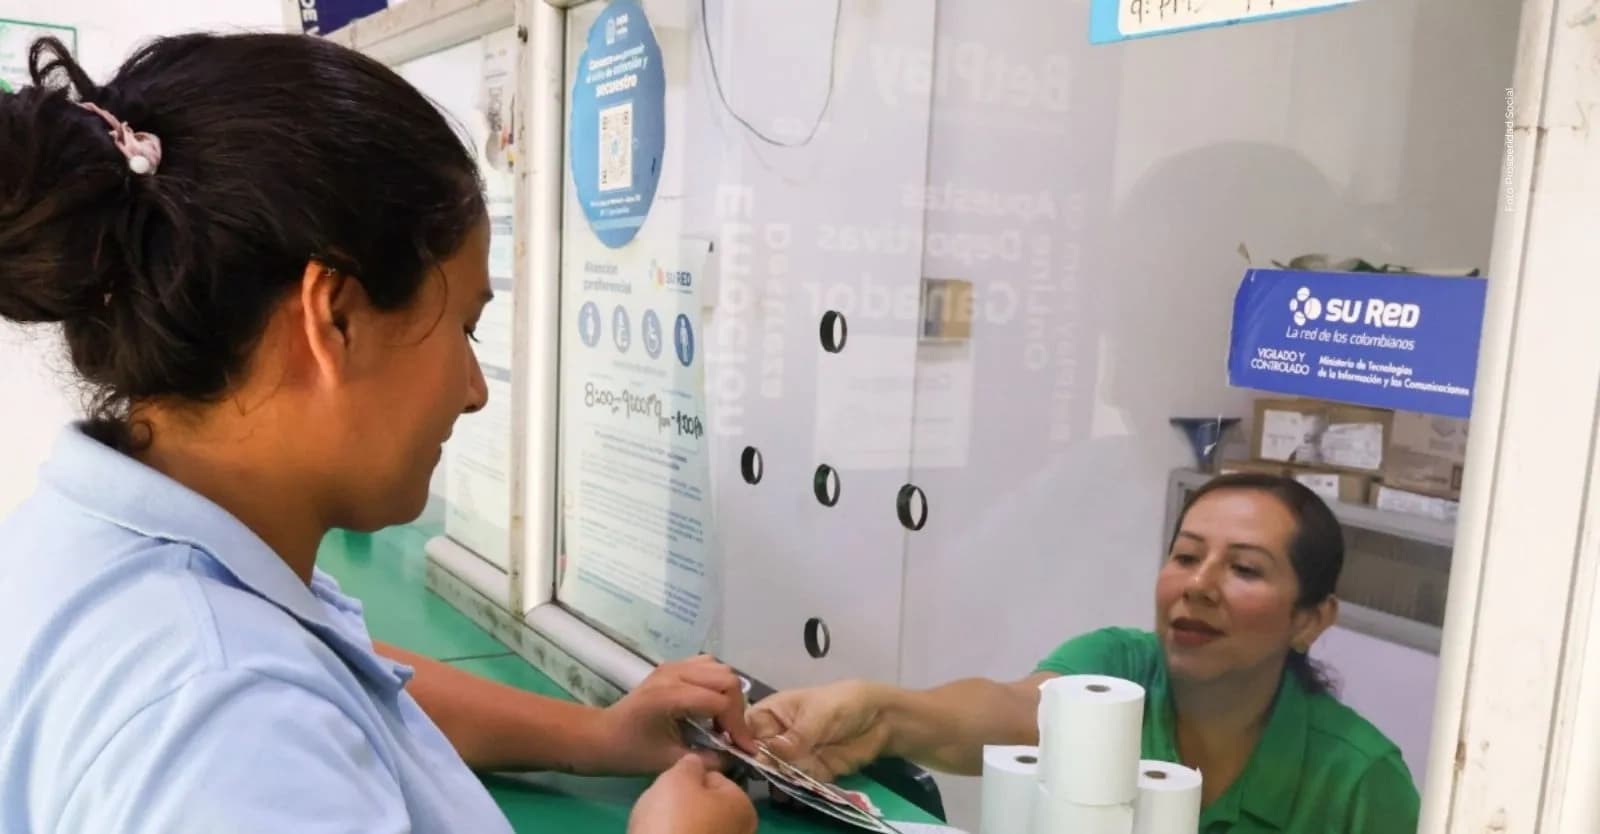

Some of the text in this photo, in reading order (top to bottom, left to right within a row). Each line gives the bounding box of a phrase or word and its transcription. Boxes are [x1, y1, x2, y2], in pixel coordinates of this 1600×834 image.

[1325, 298, 1362, 323] SU
[1286, 326, 1415, 351] La red de los colombianos
[1258, 348, 1306, 362] VIGILADO Y
[1318, 355, 1354, 369] Ministerio
[1356, 358, 1366, 370] de
[1251, 358, 1310, 375] CONTROLADO
[1317, 367, 1327, 377] de
[1329, 369, 1336, 378] la
[1383, 378, 1388, 388] y
